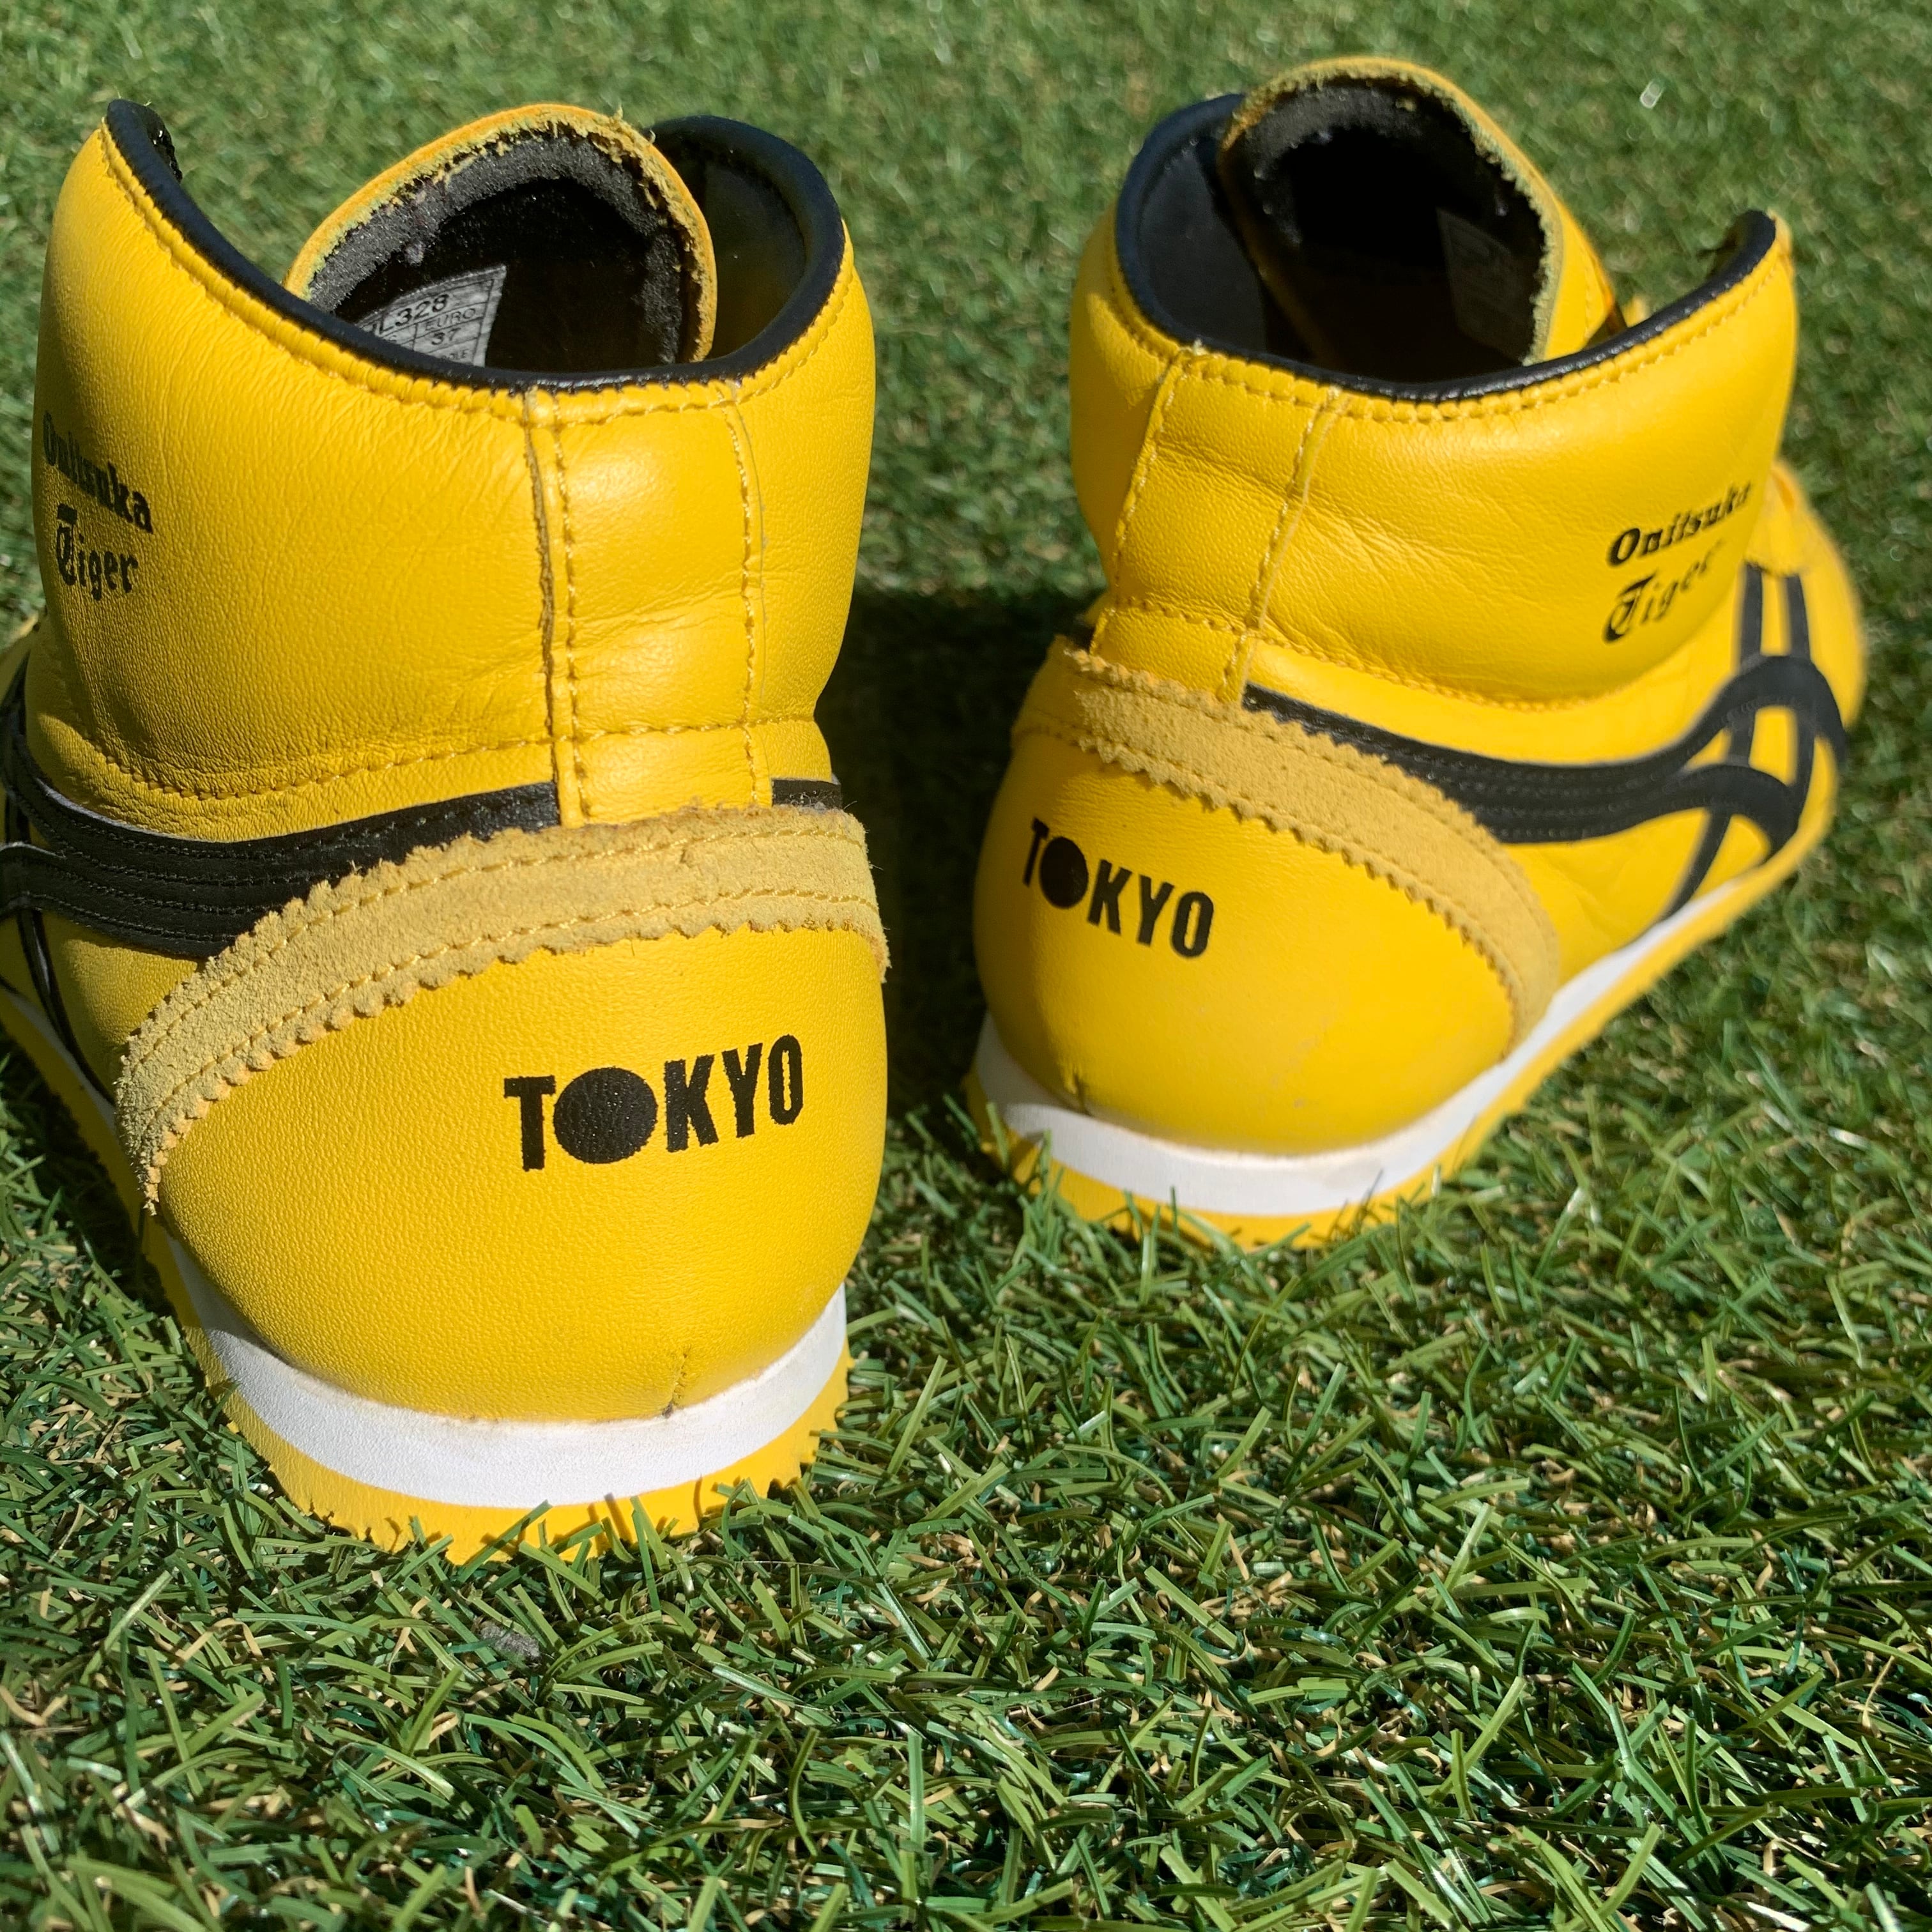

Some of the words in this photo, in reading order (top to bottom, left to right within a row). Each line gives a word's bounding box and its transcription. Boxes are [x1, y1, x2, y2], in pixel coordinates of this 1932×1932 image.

[425, 308, 476, 331] EURO
[431, 327, 461, 346] 37
[55, 502, 139, 601] Tiger
[1602, 538, 1722, 644] Tiger
[1023, 816, 1215, 959] TOKYO
[503, 1034, 804, 1172] TOKYO
